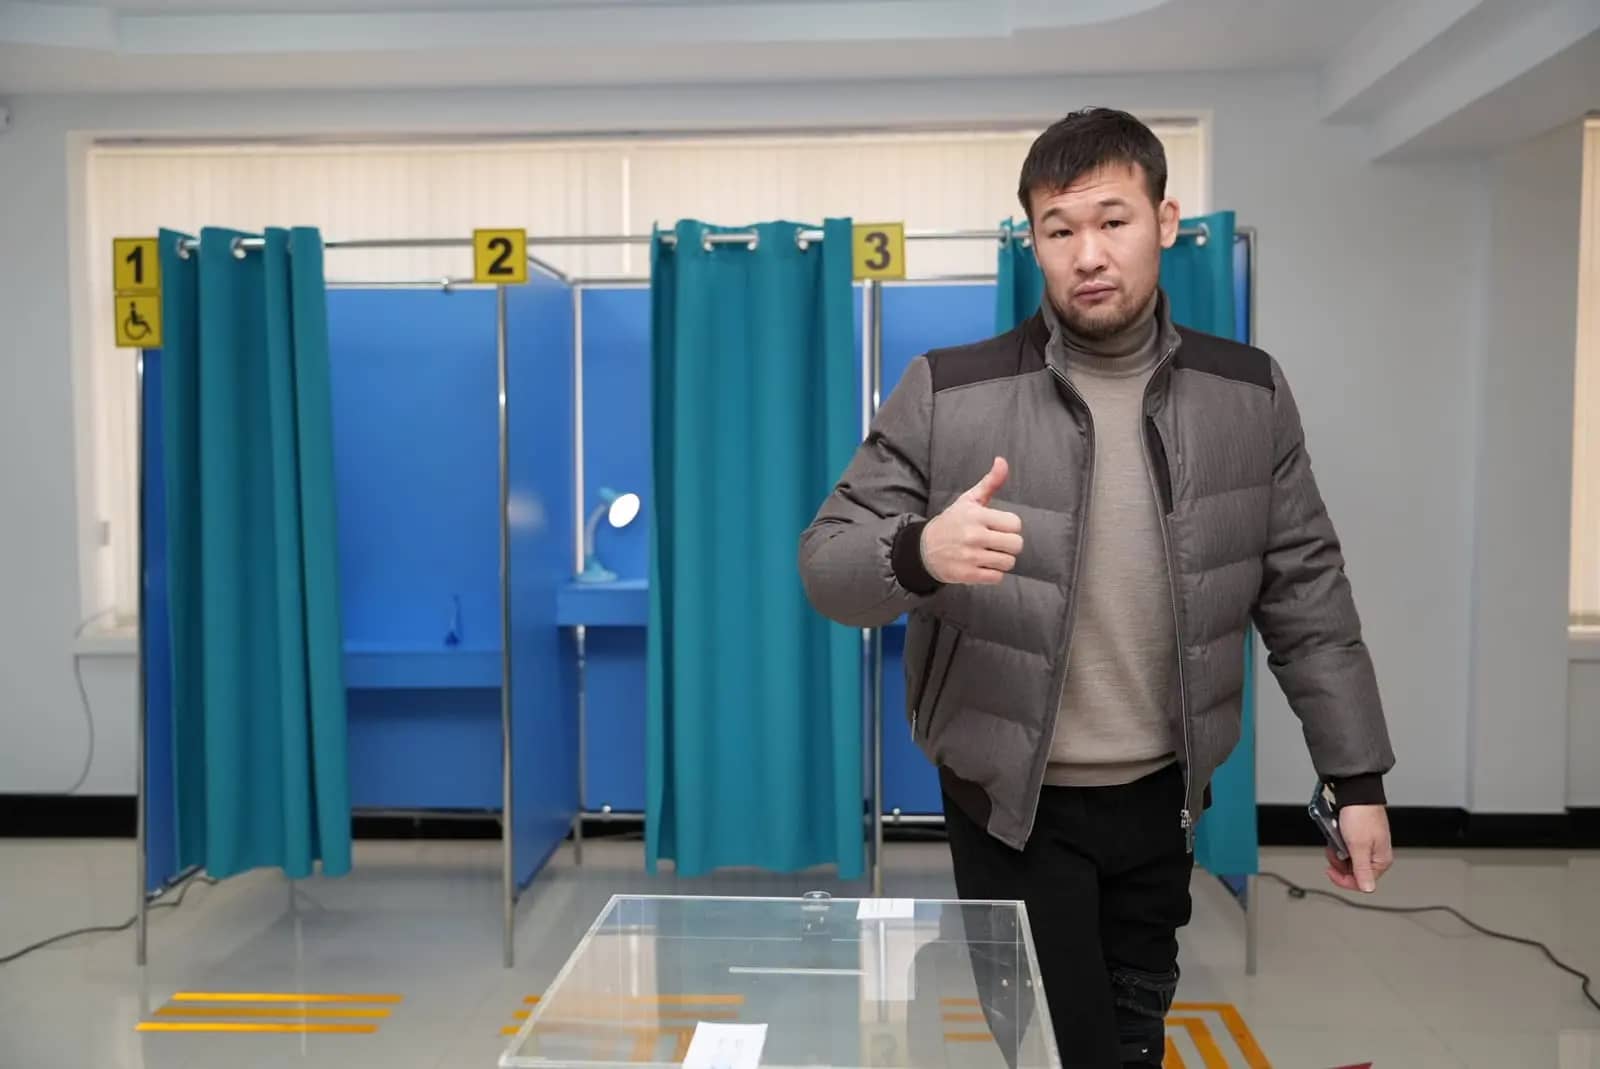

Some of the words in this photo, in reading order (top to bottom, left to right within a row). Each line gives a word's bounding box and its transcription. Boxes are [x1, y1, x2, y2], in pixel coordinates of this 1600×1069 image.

[126, 246, 143, 284] 1
[488, 237, 513, 275] 2
[864, 232, 891, 271] 3
